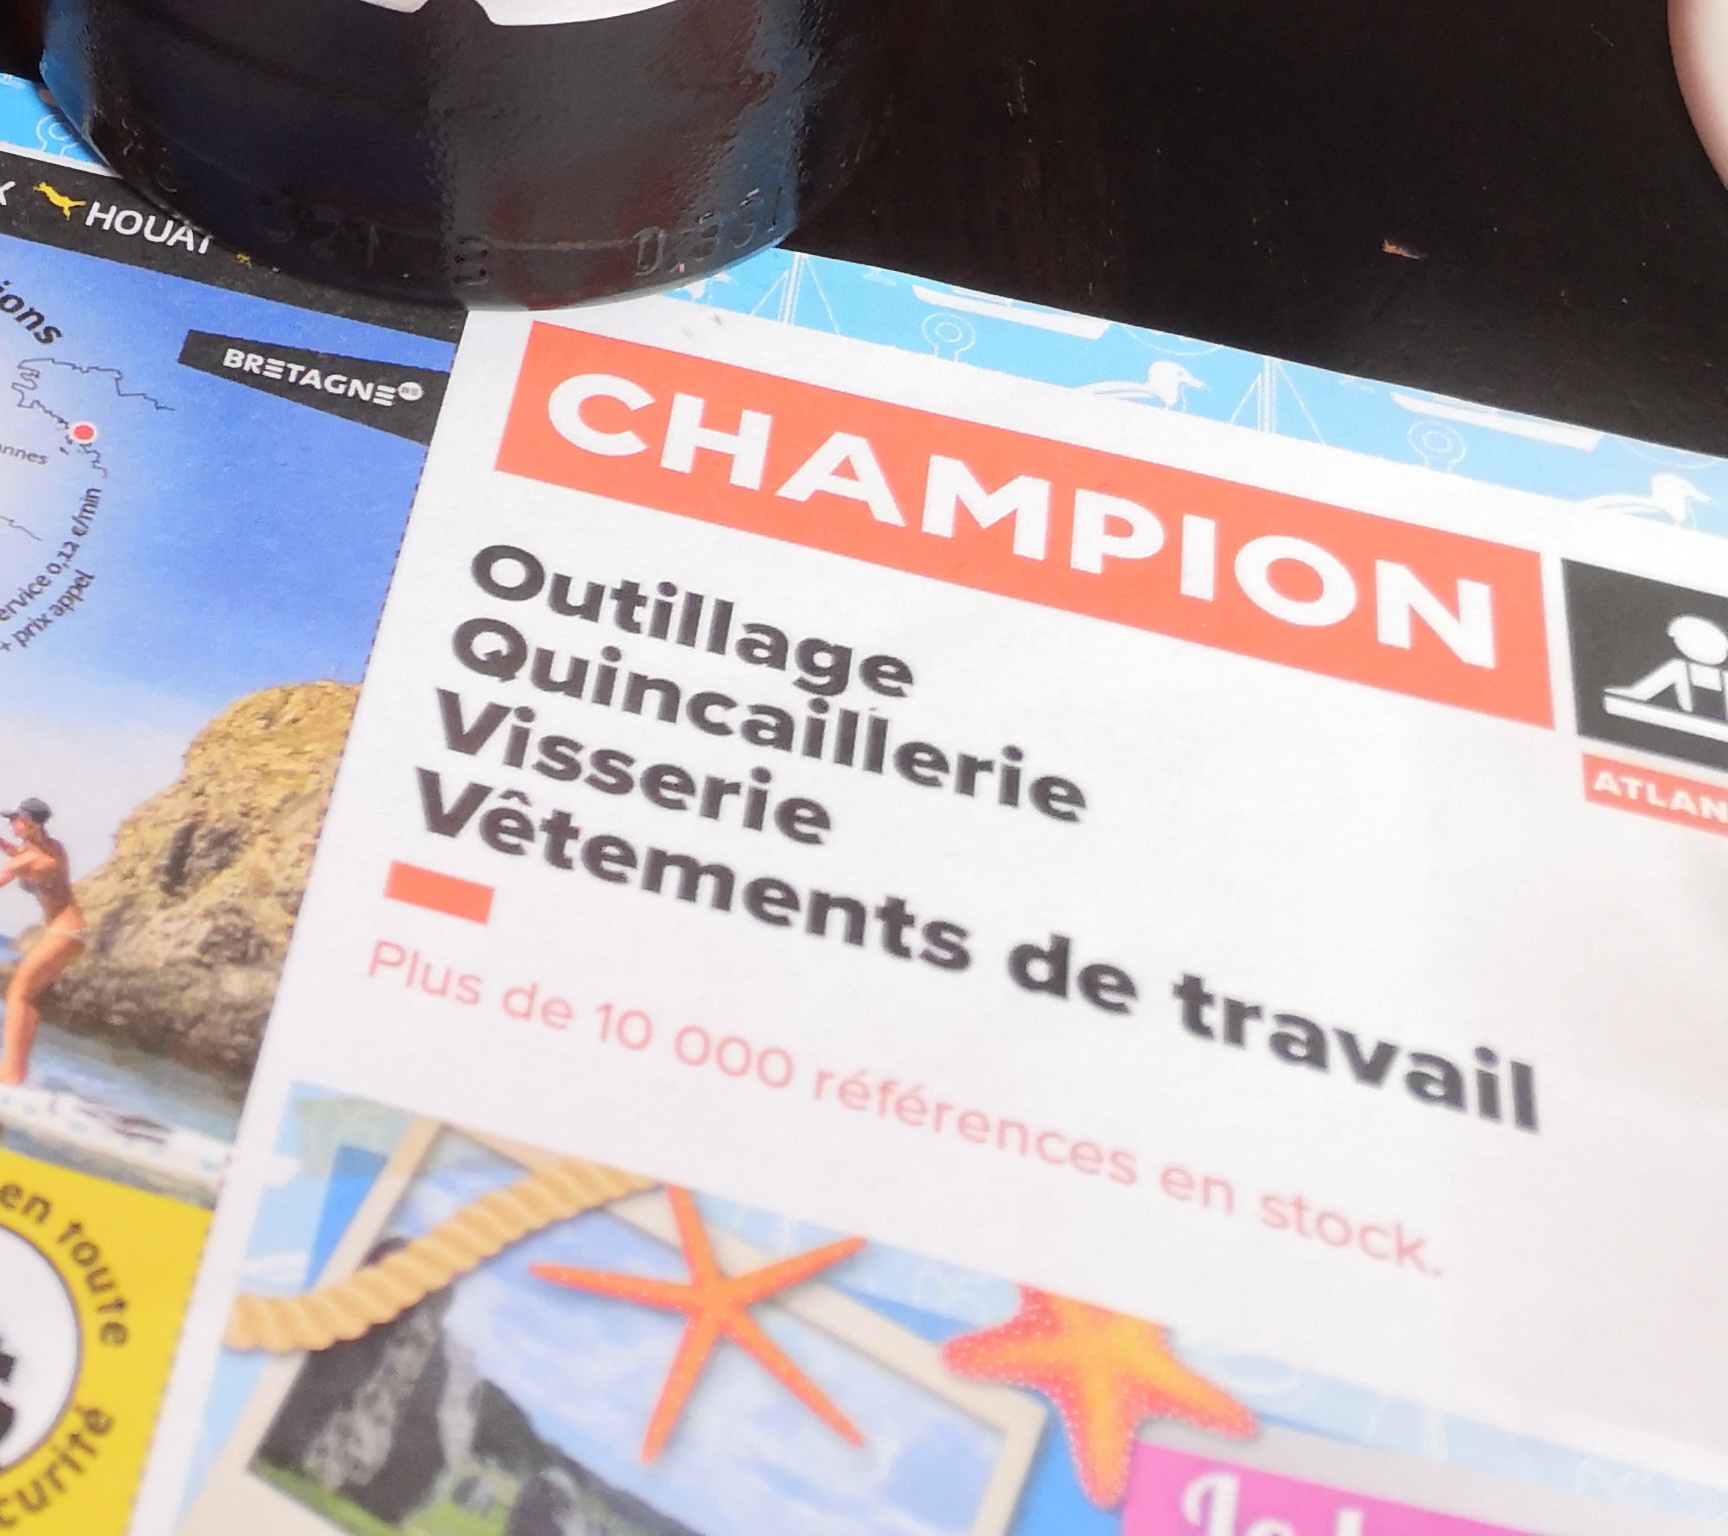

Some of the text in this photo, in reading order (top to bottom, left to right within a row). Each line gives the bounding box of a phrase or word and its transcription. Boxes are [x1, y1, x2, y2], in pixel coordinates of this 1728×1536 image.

[222, 347, 398, 407] BRETAGNE
[546, 373, 1497, 670] CHAMPION
[11, 613, 54, 648] prix
[48, 568, 96, 619] appel
[469, 542, 916, 698] Outillage
[434, 687, 833, 846] Visserie
[450, 615, 1088, 824] Quincaillerie
[413, 766, 1539, 1134] Vêtements de travail
[368, 939, 1444, 1278] Plus de 10 000 références en stock.
[56, 1220, 130, 1348] toute
